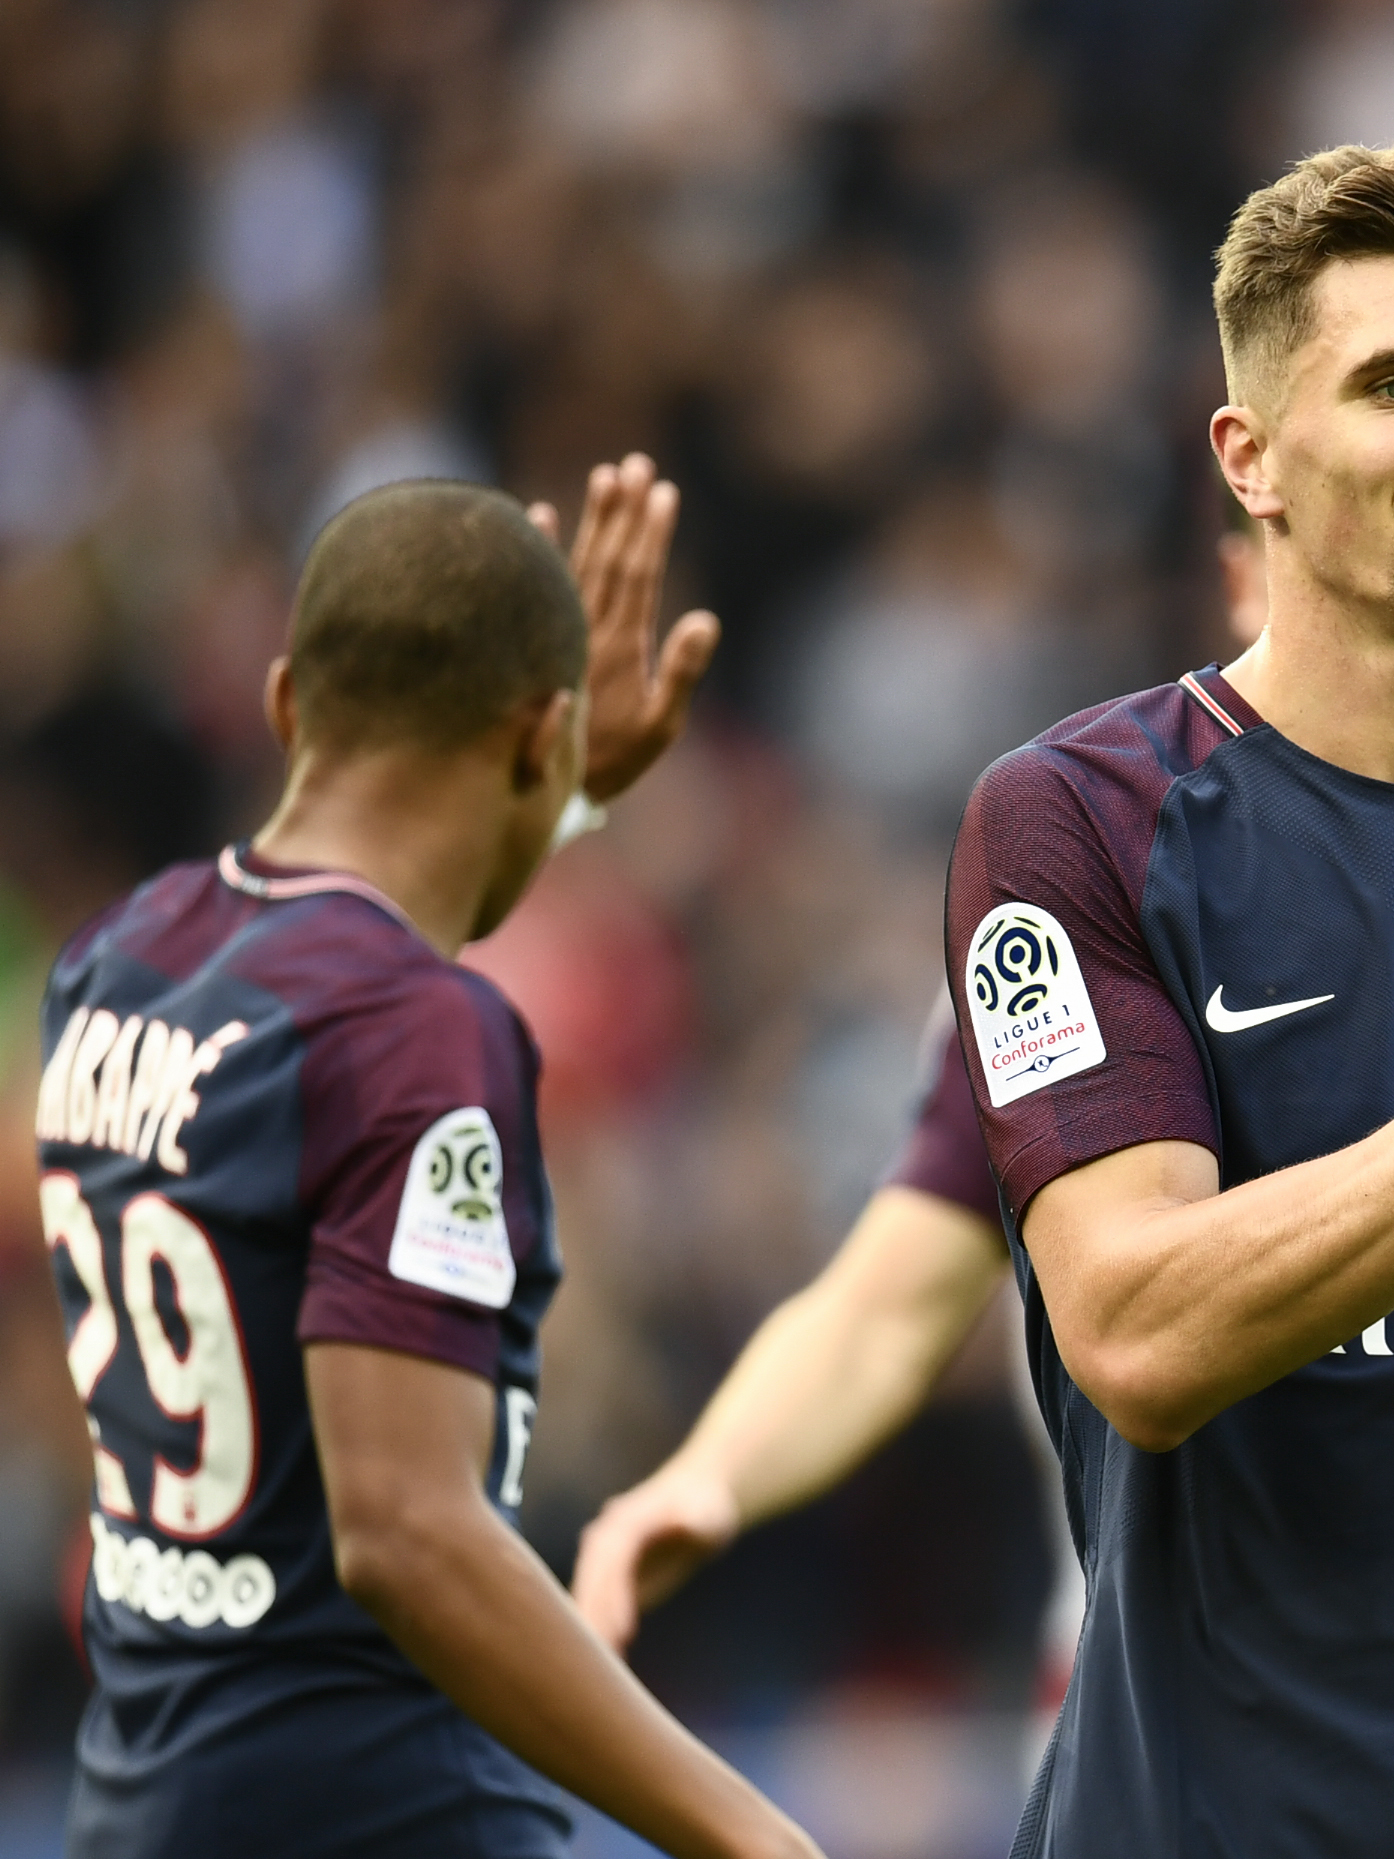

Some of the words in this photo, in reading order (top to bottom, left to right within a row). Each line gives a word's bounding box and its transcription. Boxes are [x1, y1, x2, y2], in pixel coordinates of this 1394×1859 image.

[992, 1022, 1085, 1069] Conforama
[994, 1012, 1052, 1048] LIGUE
[1062, 1004, 1070, 1016] 1
[38, 1168, 260, 1540] 29
